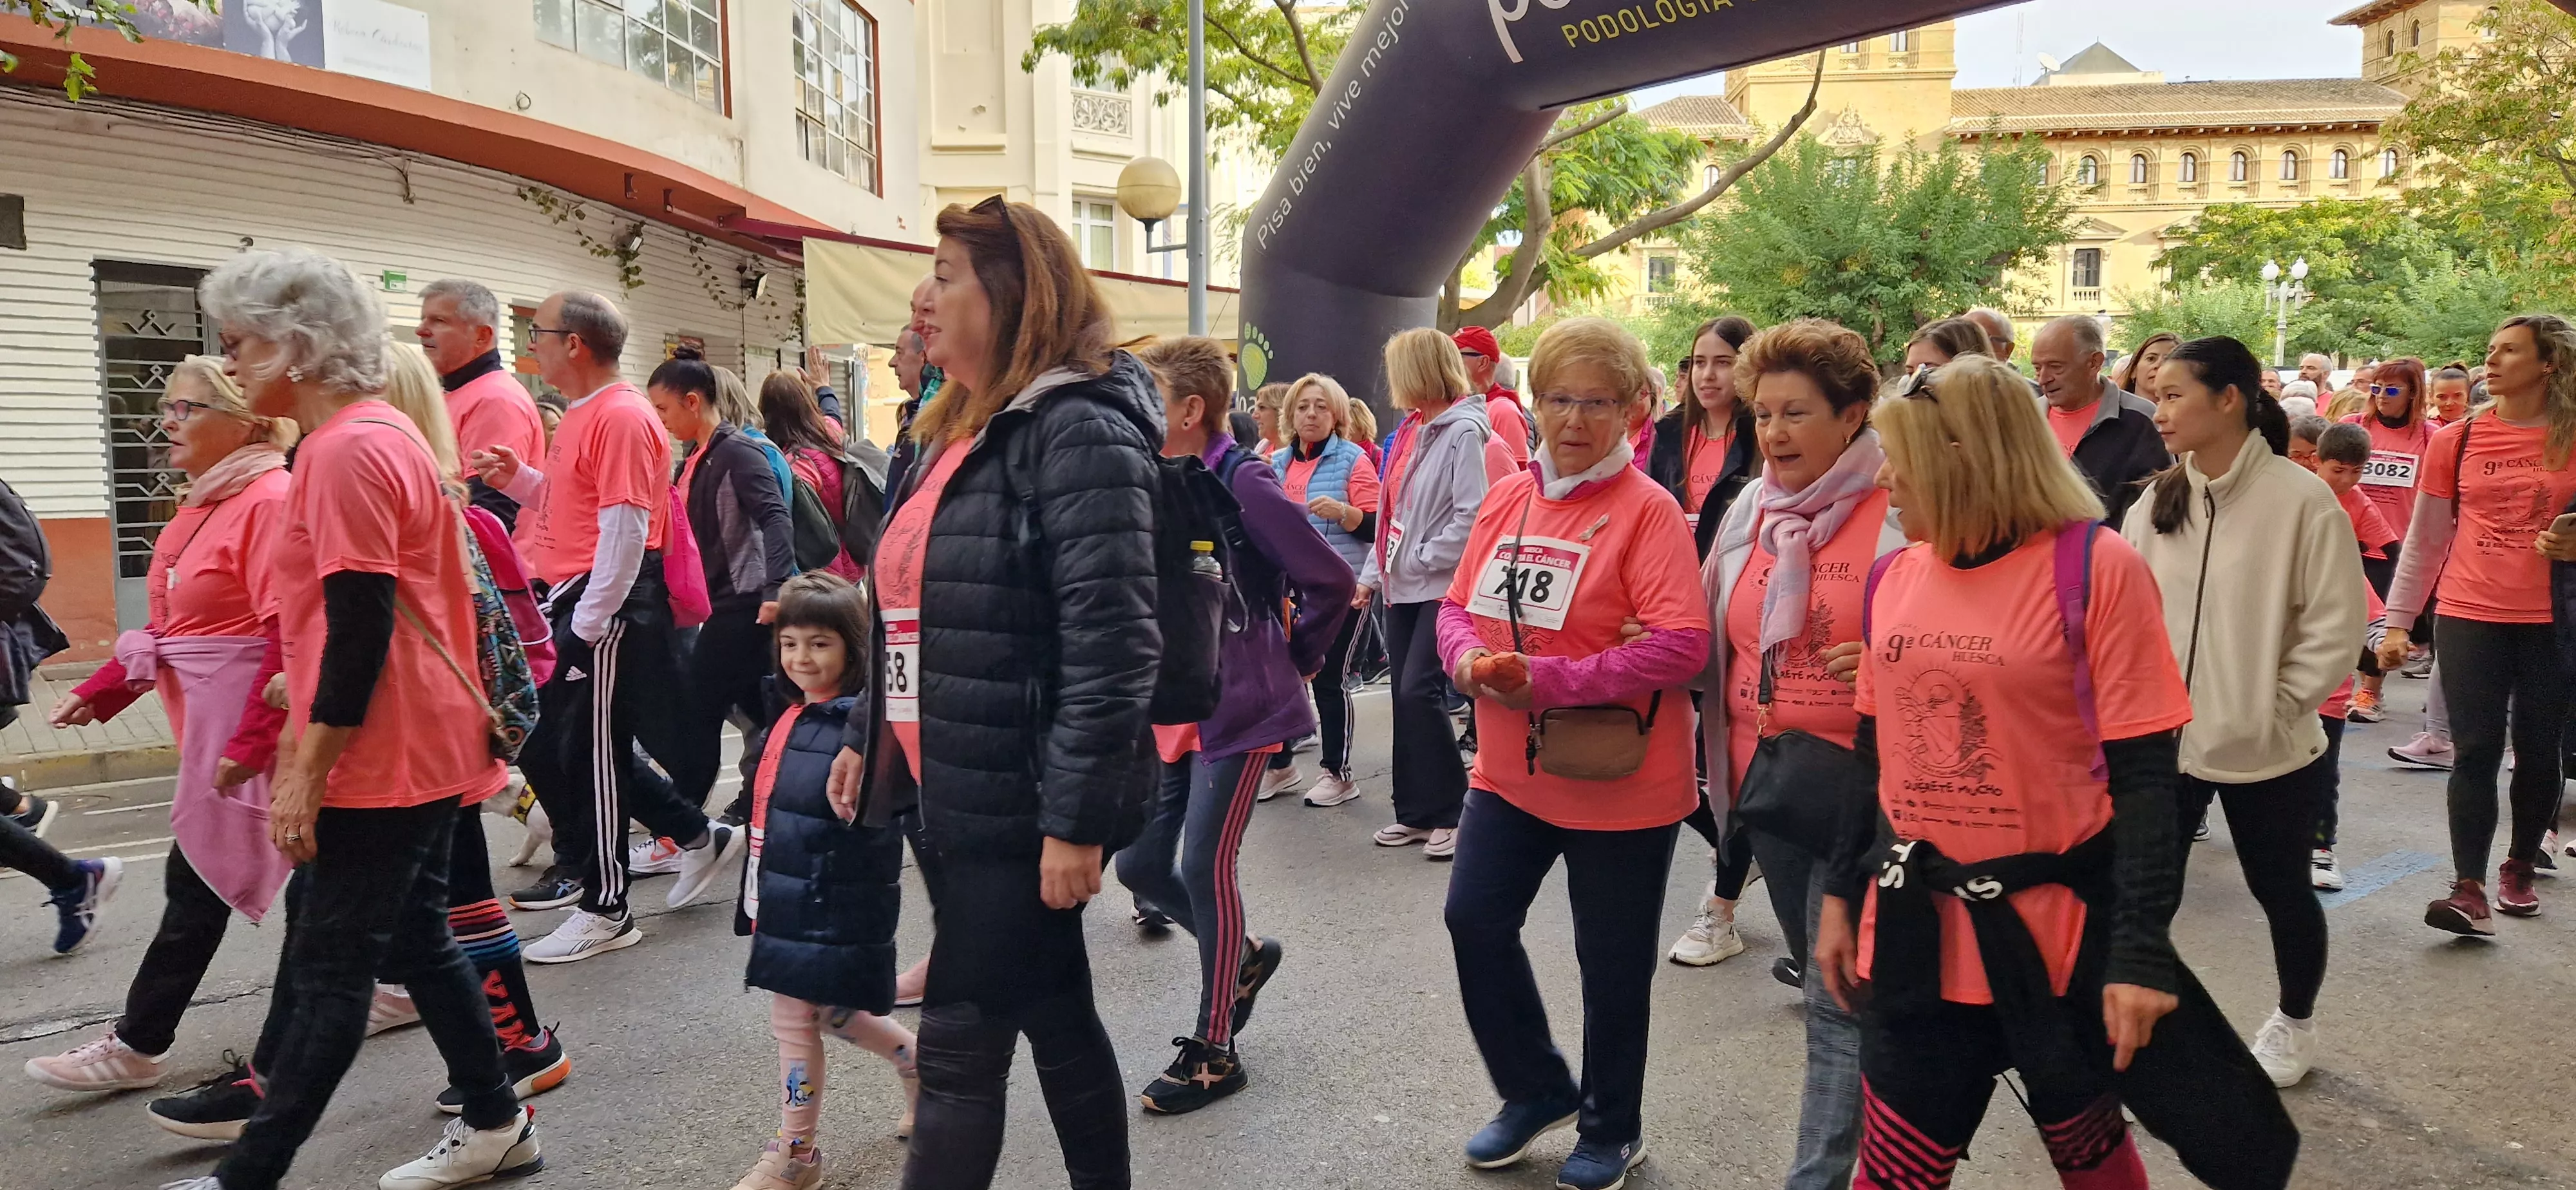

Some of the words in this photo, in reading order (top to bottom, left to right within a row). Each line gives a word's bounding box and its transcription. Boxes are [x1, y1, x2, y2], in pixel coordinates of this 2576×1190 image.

[1257, 196, 1293, 250] Pisa
[1289, 140, 1332, 196] bien,
[1328, 79, 1361, 129] vive
[2362, 462, 2410, 478] 3082
[2483, 460, 2504, 476] 9ª
[2506, 457, 2544, 468] CÁNC
[1387, 538, 1396, 559] 3
[1535, 554, 1572, 569] CÁNCER
[1493, 565, 1554, 603] 718
[1815, 573, 1860, 583] HUESCA
[1886, 634, 1915, 663] 9ª
[1919, 630, 1993, 652] CÁNCER
[1952, 651, 2005, 666] HUESCA
[1806, 672, 1837, 683] MUCH
